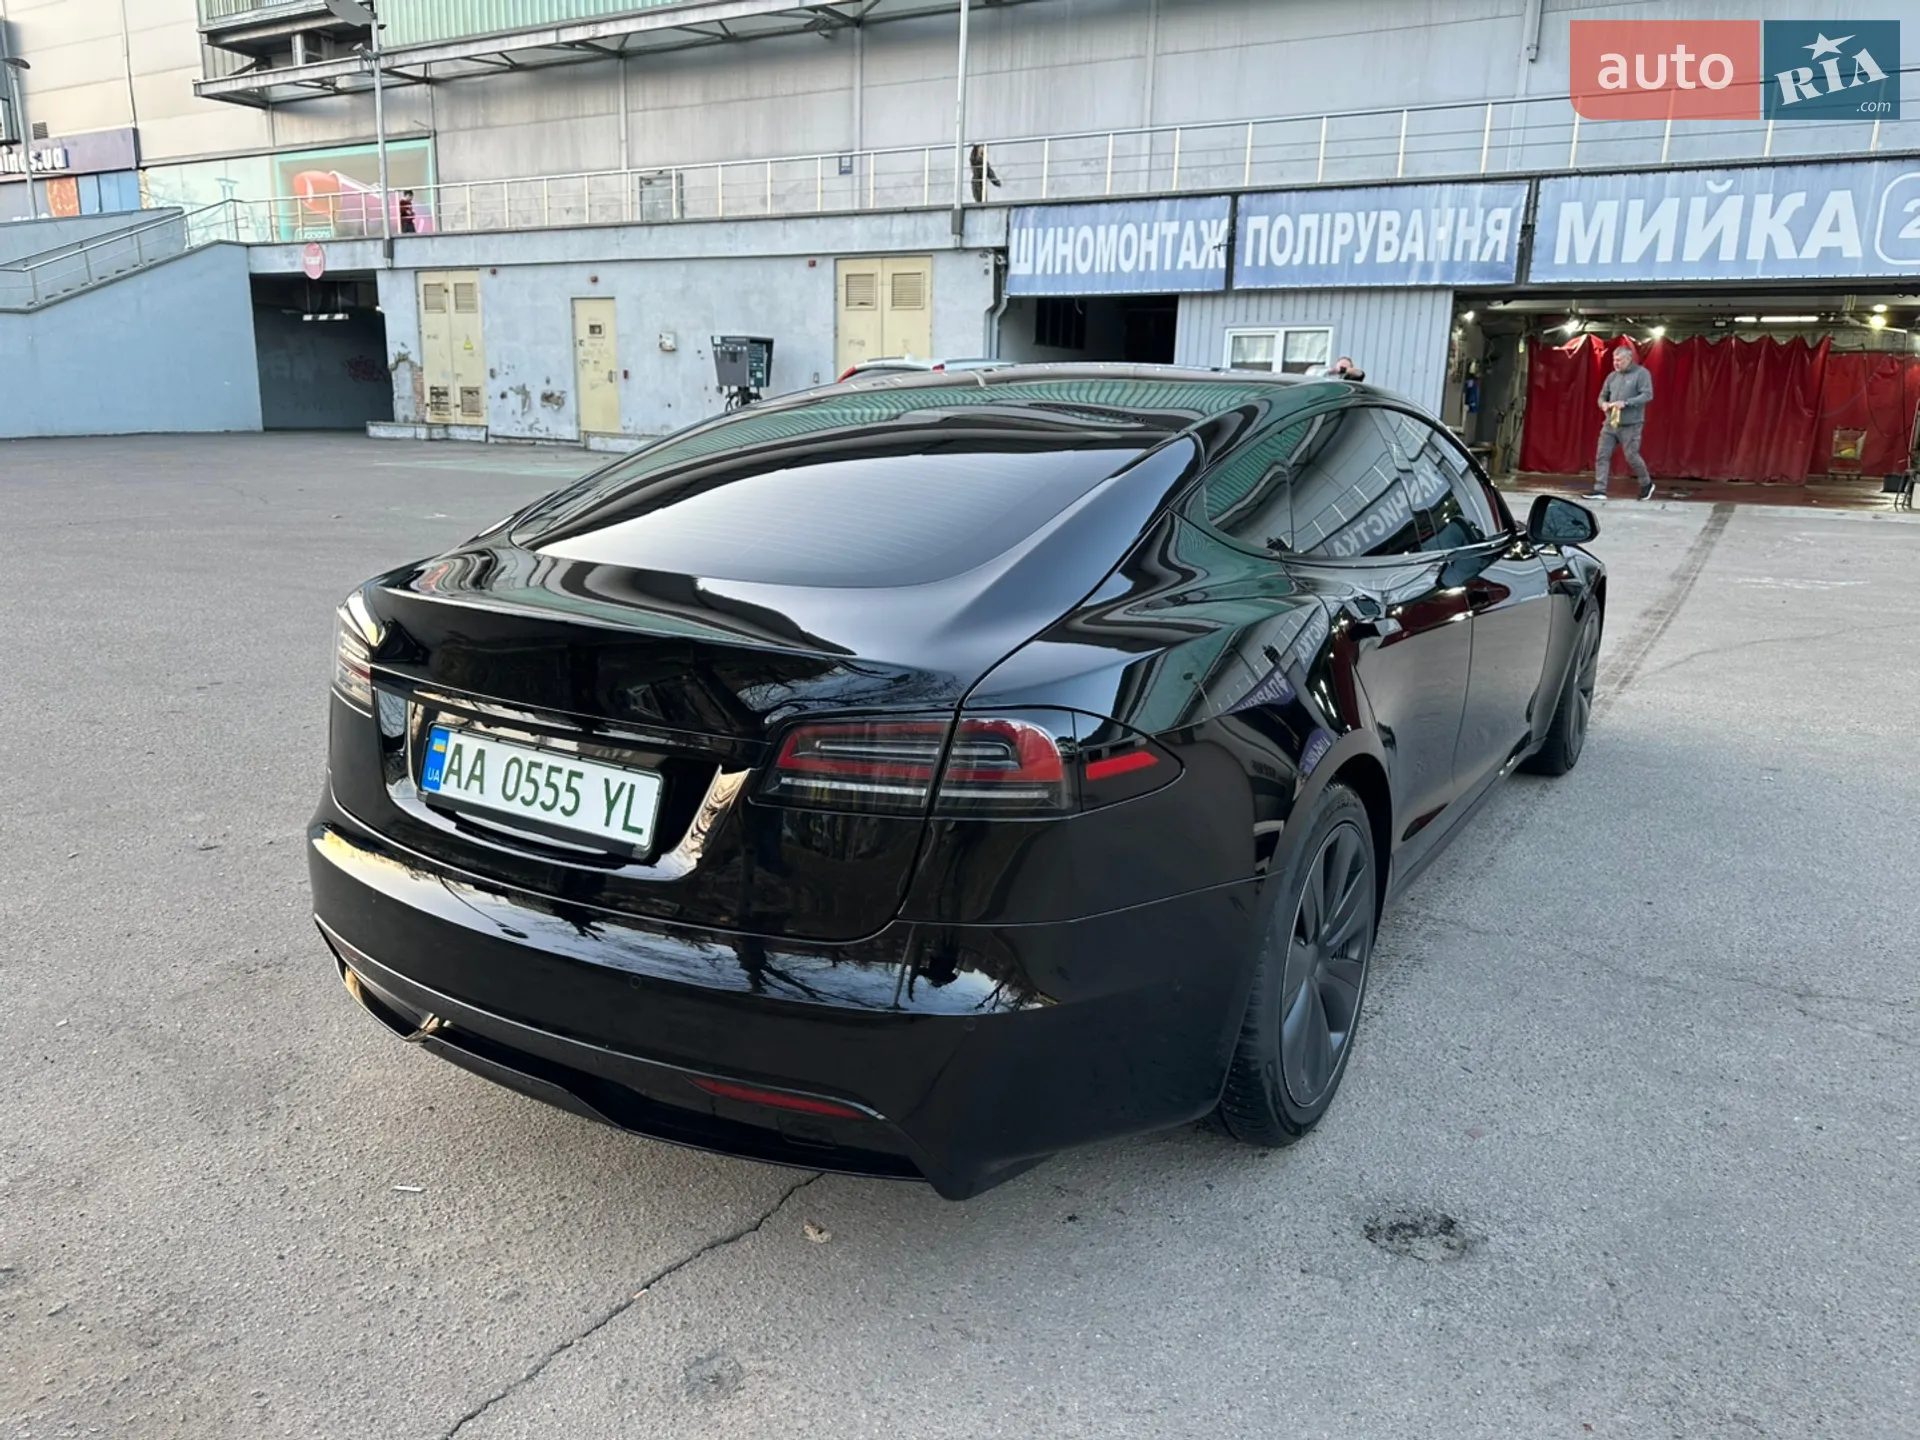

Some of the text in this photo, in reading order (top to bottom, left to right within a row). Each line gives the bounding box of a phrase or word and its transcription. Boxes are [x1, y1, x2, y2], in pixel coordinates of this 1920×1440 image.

[1009, 218, 1228, 275] ШИНОМОНТАЖ
[1244, 207, 1512, 268] ПОЛІРУВАННЯ
[1553, 179, 1864, 265] МИЙКА
[426, 767, 441, 783] UA
[443, 742, 644, 836] AA 0555 YL
